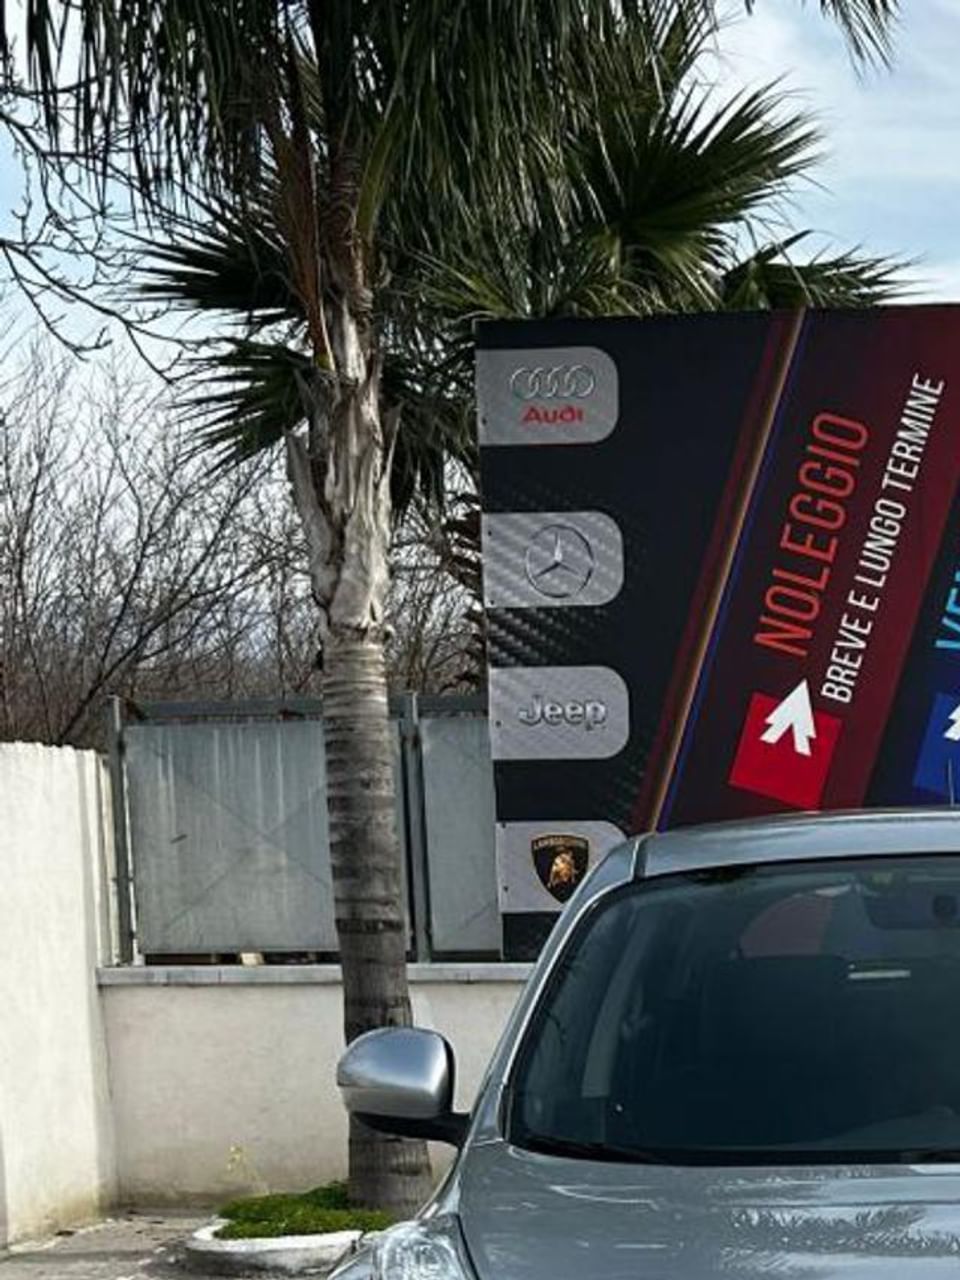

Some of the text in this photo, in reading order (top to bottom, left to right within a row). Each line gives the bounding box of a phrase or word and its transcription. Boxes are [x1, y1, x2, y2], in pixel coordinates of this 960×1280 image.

[521, 404, 584, 424] Audi
[754, 411, 869, 657] NOLEGGIO
[821, 373, 945, 704] BREVE E LUNGO TERMINE
[517, 694, 607, 732] Jeep
